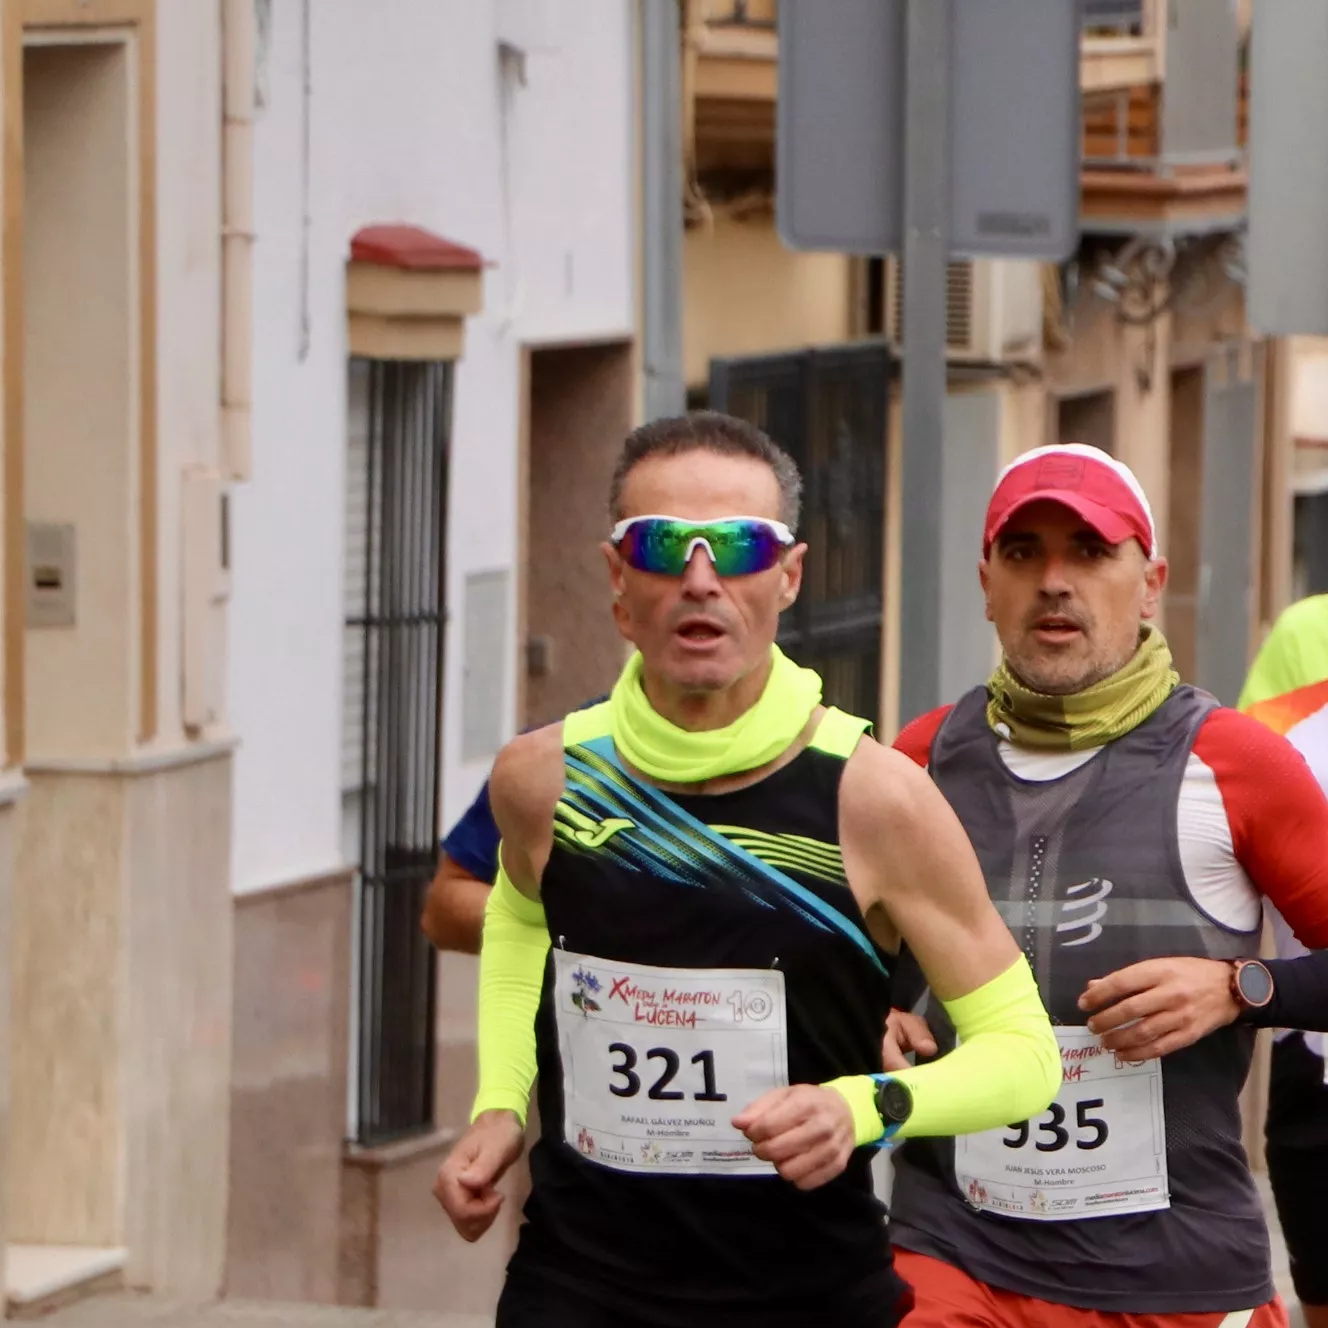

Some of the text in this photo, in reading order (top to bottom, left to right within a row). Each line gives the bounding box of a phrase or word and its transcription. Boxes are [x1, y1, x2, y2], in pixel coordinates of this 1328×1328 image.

[608, 1042, 728, 1102] 321
[1045, 1167, 1066, 1176] VERA
[1067, 1164, 1107, 1175] MOSCOSO
